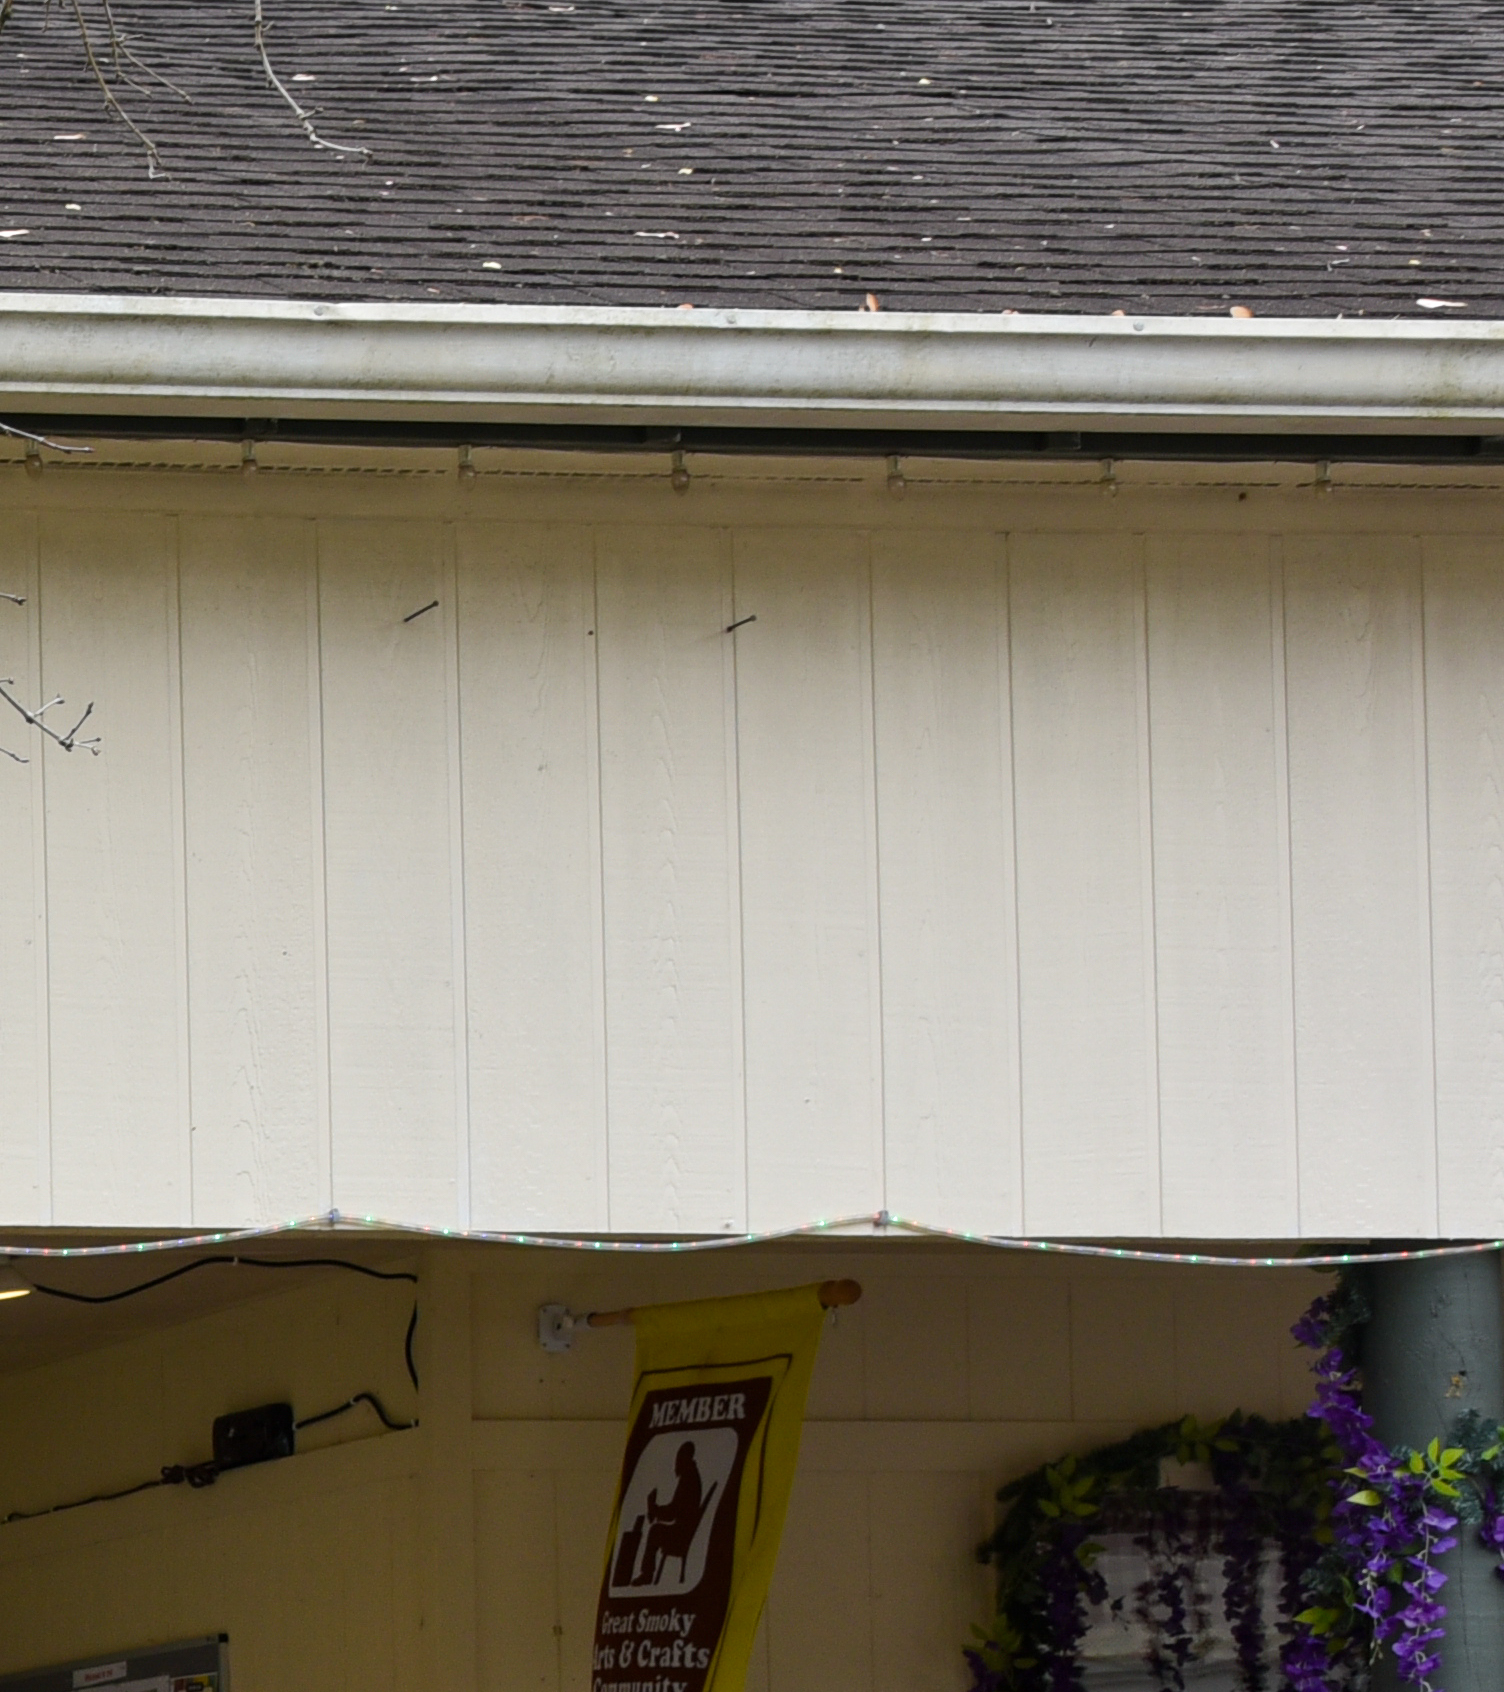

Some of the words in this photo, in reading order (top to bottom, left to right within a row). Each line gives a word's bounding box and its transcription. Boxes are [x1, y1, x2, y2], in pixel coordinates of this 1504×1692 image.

[648, 1393, 746, 1429] MEMBER
[601, 1610, 635, 1635] Great
[636, 1607, 697, 1638] Smoky
[619, 1639, 635, 1669] &
[637, 1638, 711, 1670] Crafts
